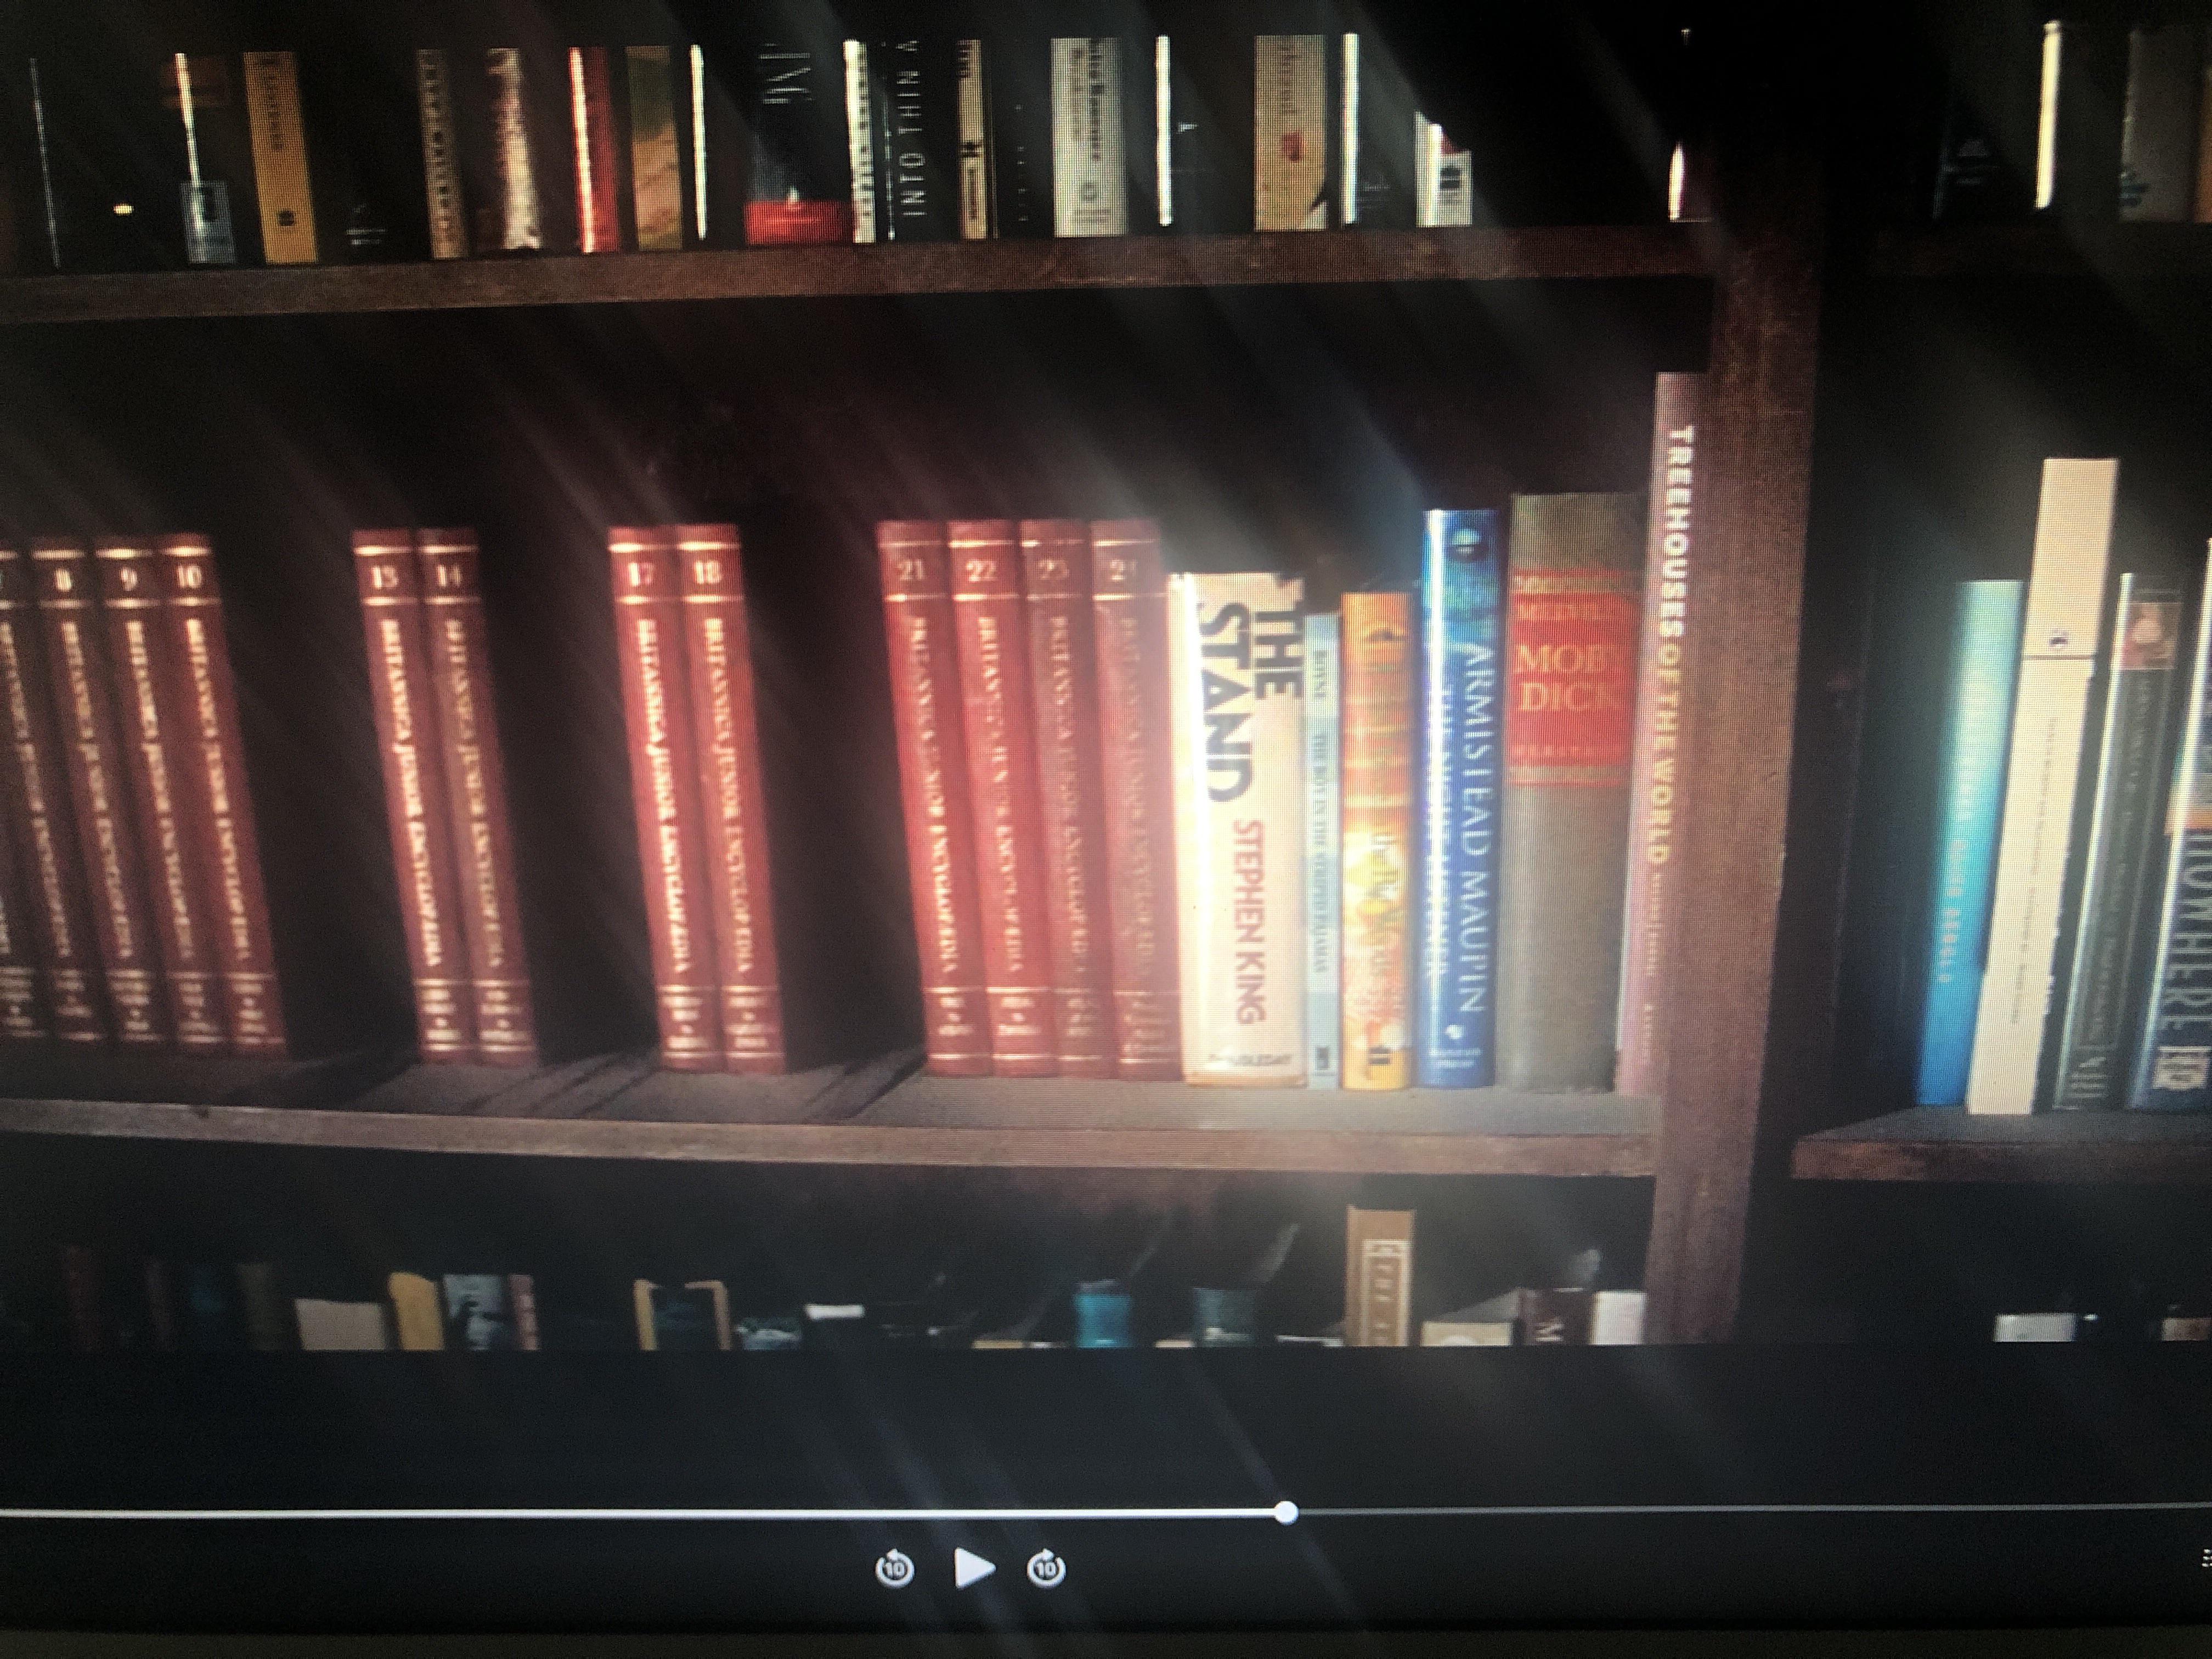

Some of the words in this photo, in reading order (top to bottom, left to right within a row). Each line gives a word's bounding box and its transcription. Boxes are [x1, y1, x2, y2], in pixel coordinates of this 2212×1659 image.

[896, 70, 922, 134] THIN
[898, 152, 928, 217] INTO
[1657, 425, 1695, 637] TREEHOUSES
[177, 564, 203, 589] 10
[693, 560, 723, 585] 18
[896, 558, 926, 582] 21
[965, 558, 999, 583] 22
[1255, 602, 1304, 699] THE
[1657, 642, 1682, 684] OF
[1197, 602, 1253, 802] STAND
[1654, 689, 1679, 749] THE
[1451, 642, 1497, 856] ARMISTEAD
[1646, 758, 1674, 864] WORLD
[1233, 819, 1266, 944] STEPHEN
[1458, 871, 1492, 1013] MAUPIN
[1235, 951, 1267, 1025] KING
[884, 1562, 905, 1577] 10
[1034, 1562, 1056, 1577] 10
